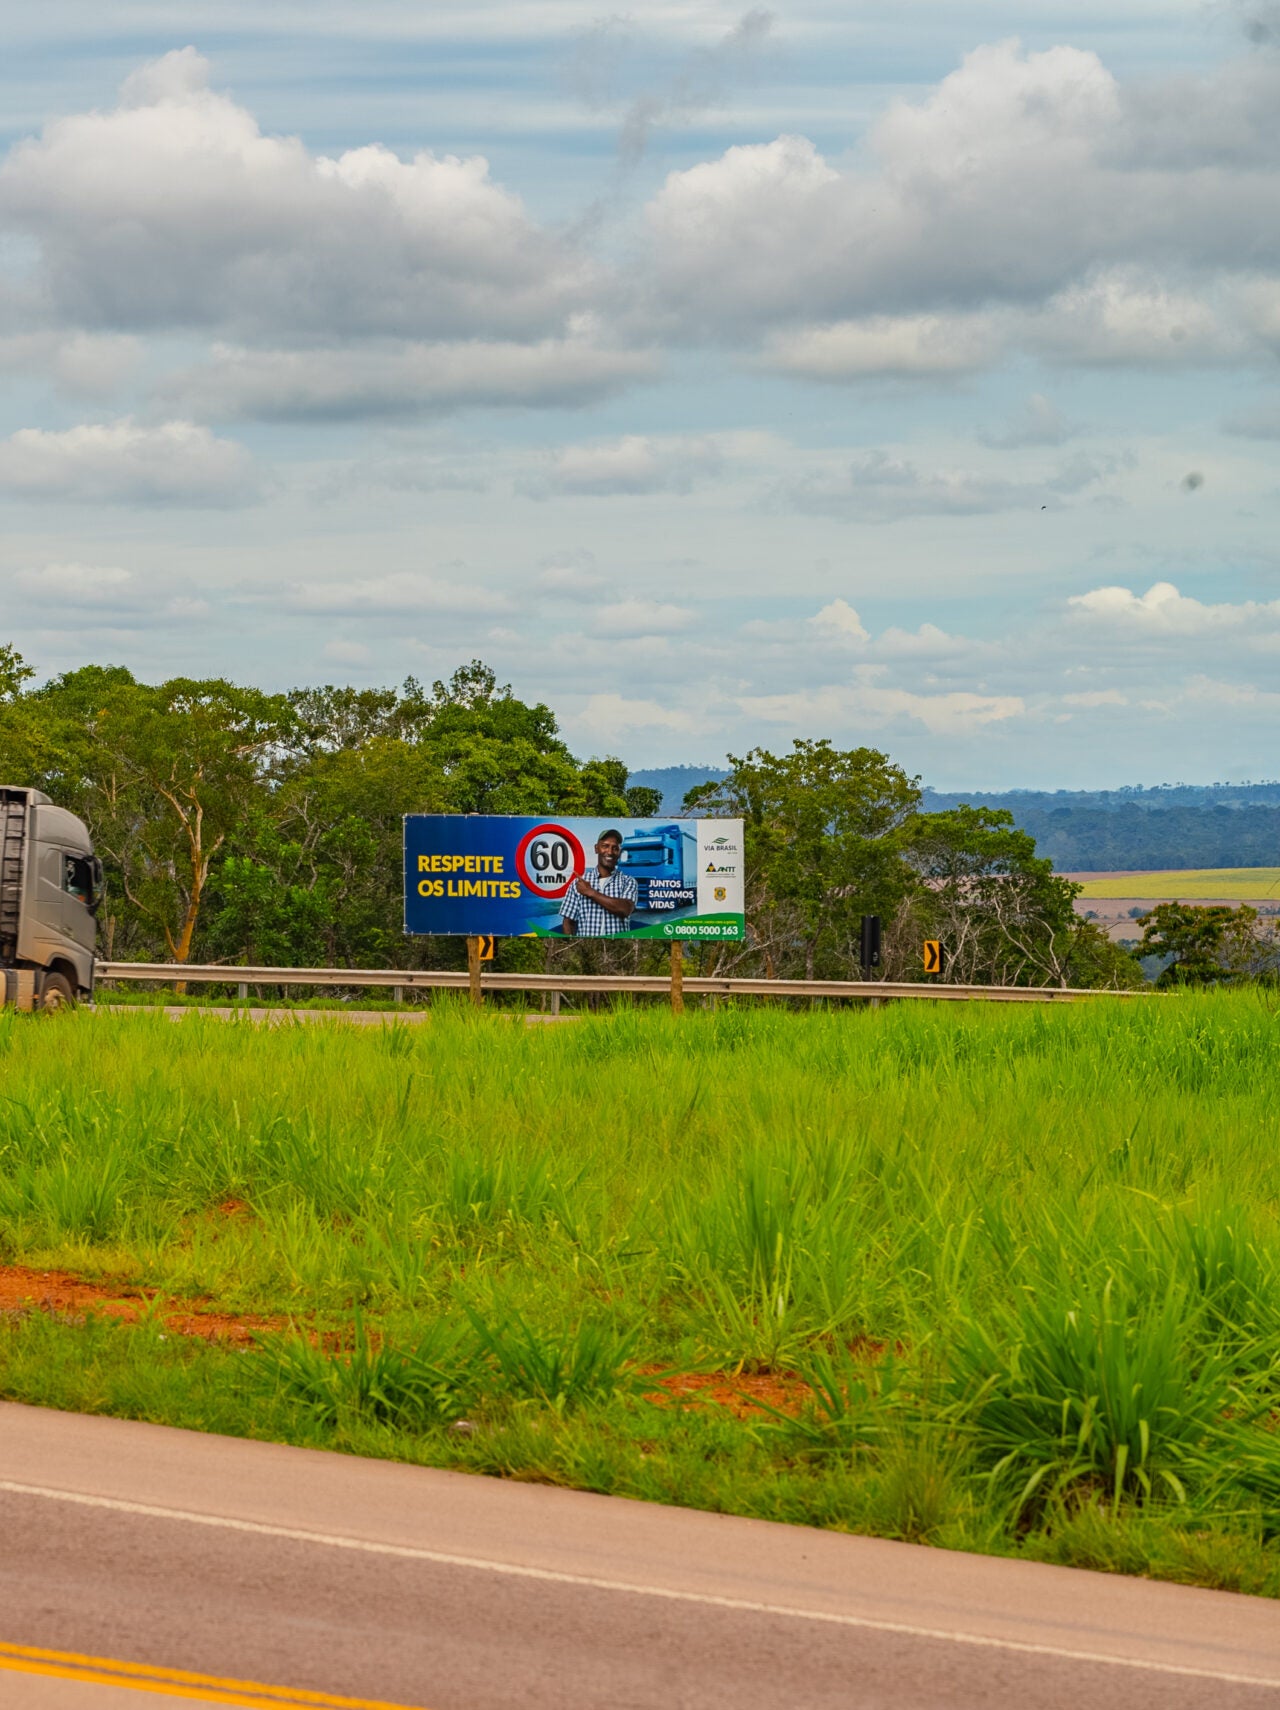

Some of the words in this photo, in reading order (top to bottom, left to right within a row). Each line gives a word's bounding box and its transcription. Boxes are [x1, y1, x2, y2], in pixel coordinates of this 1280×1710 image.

[530, 839, 569, 871] 60
[417, 855, 504, 873] RESPEITE
[536, 873, 567, 884] km/h
[648, 879, 681, 888] JUNTOS
[417, 879, 444, 897] OS
[447, 879, 522, 899] LIMITES
[648, 890, 694, 899] SALVAMOS
[648, 900, 675, 909] VIDAS
[675, 925, 697, 935] 0800
[698, 926, 721, 935] 5000
[722, 926, 739, 935] 163
